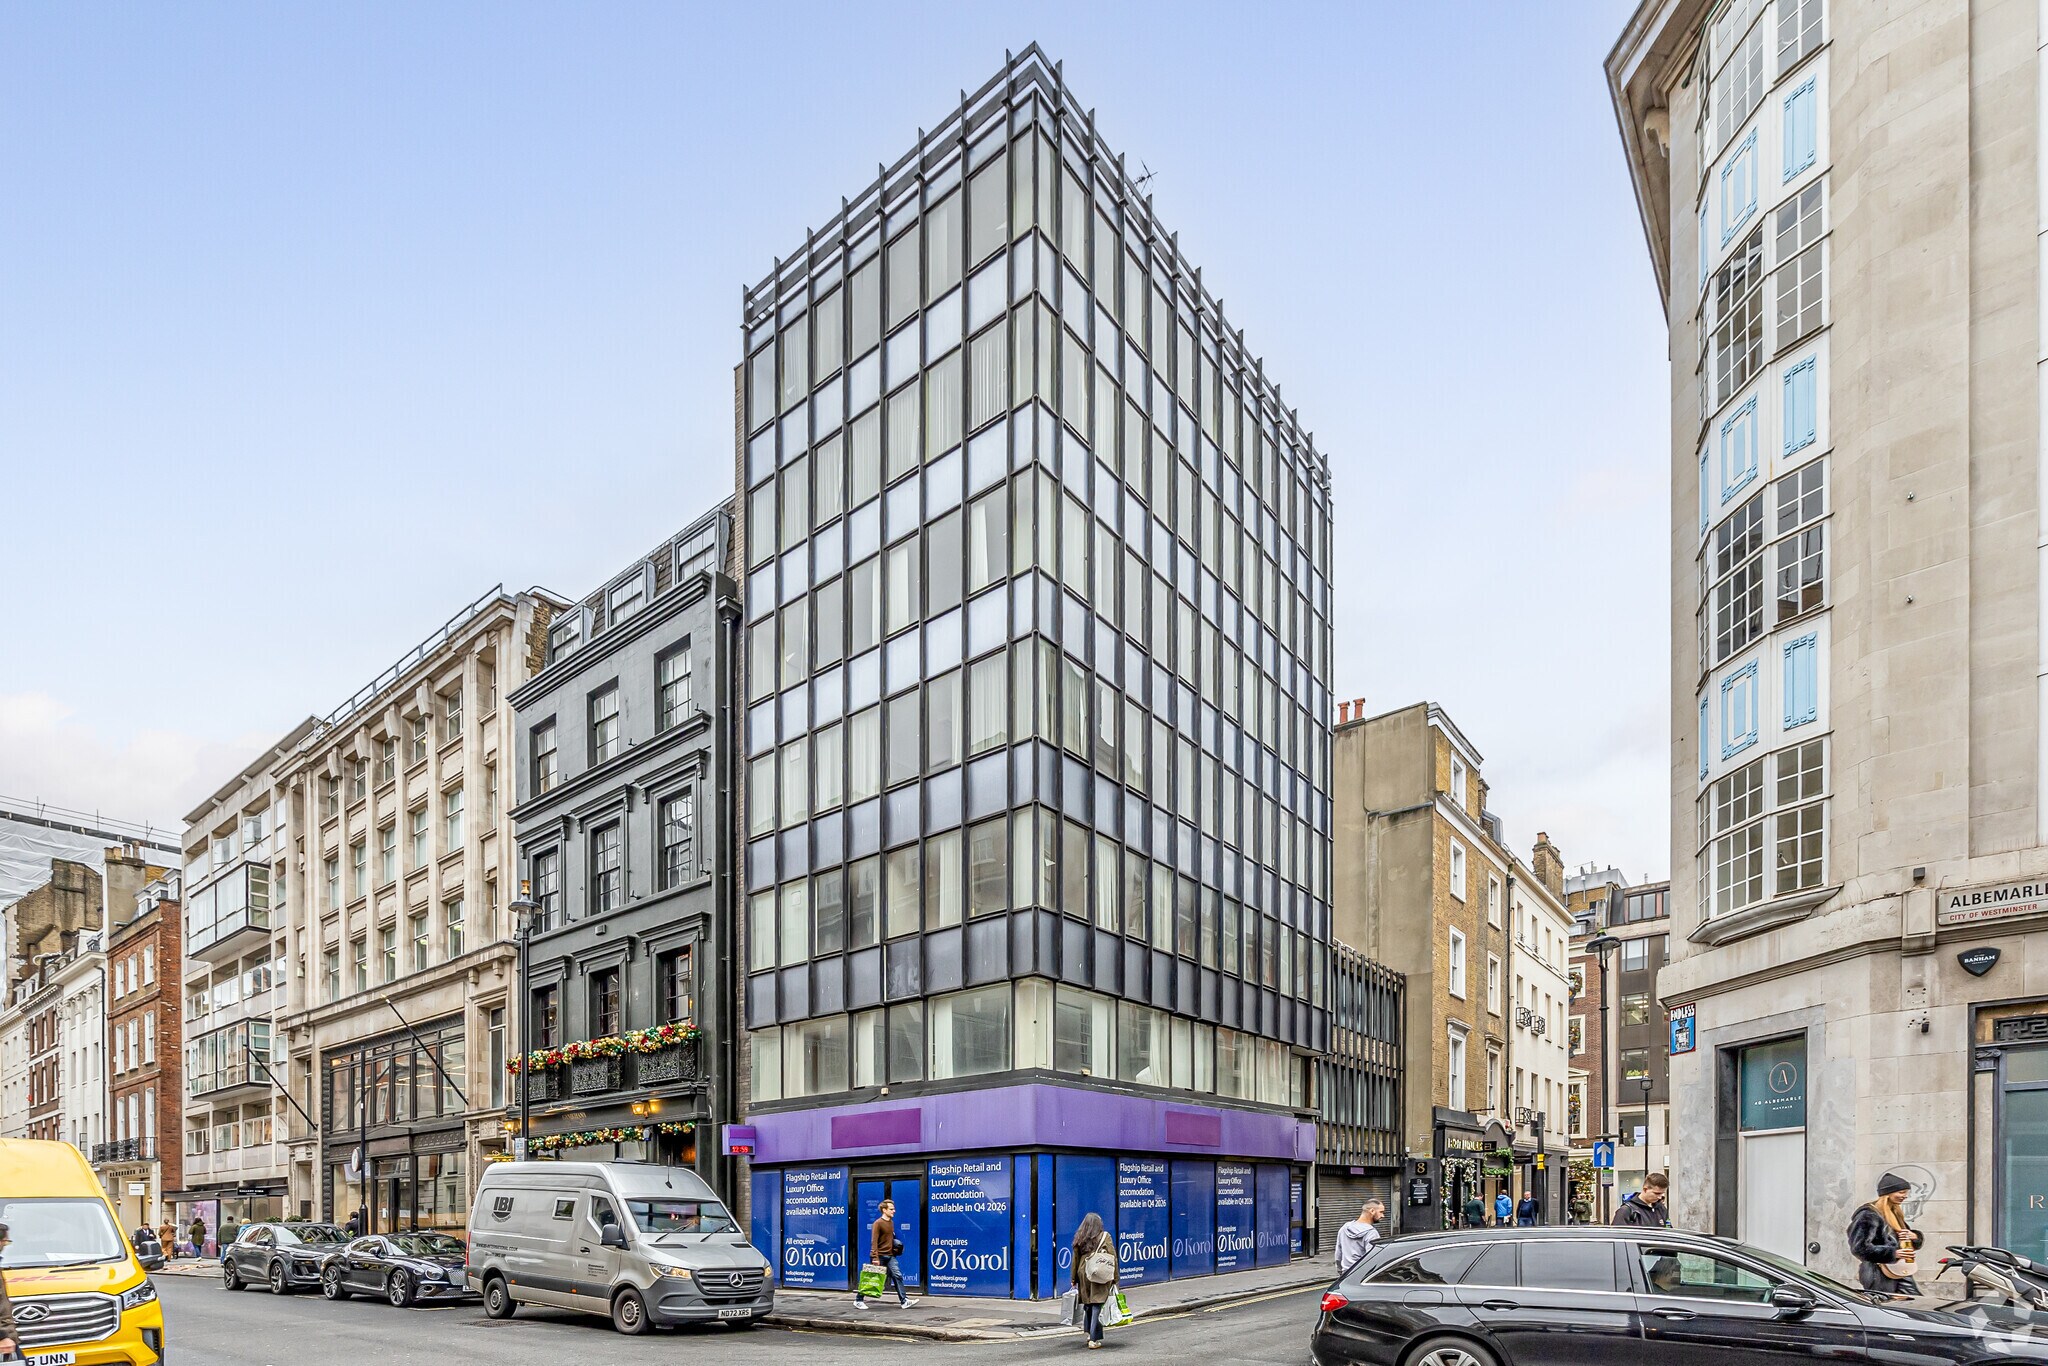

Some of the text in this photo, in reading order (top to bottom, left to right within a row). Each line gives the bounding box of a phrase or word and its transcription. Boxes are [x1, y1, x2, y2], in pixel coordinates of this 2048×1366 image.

[1981, 904, 2038, 917] WESTMINSTER
[1964, 955, 1996, 963] BANHAM
[1765, 1096, 1801, 1104] ALBEMARLE
[931, 1162, 1001, 1175] Flagship Retail and
[1120, 1163, 1164, 1173] Flagship Retail and
[1218, 1167, 1233, 1175] Flagship
[1417, 1162, 1425, 1173] 8
[786, 1171, 841, 1183] Flagship Retail and
[1120, 1175, 1152, 1185] Luxury Office
[1218, 1177, 1230, 1185] Luxury
[931, 1177, 980, 1188] Luxury Office
[786, 1184, 824, 1194] Luxury Office
[1120, 1188, 1154, 1196] accomodation
[786, 1196, 827, 1204] accomodation
[931, 1190, 984, 1200] accomodation
[493, 1196, 515, 1211] IBI
[931, 1202, 1007, 1212] available in Q4 2026
[1120, 1200, 1141, 1208] available
[1147, 1200, 1154, 1208] Q4
[2030, 1195, 2046, 1209] R
[786, 1207, 811, 1215] available
[819, 1207, 828, 1215] Q4
[793, 1238, 815, 1246] enquires
[940, 1238, 968, 1247] enquires
[1228, 1230, 1254, 1251] Korol
[1266, 1228, 1289, 1247] Korol
[1133, 1237, 1167, 1261] Korol
[1185, 1234, 1214, 1256] Korol
[801, 1245, 846, 1267] Korol
[951, 1246, 1009, 1271] Korol
[40, 1353, 68, 1365] UNN
